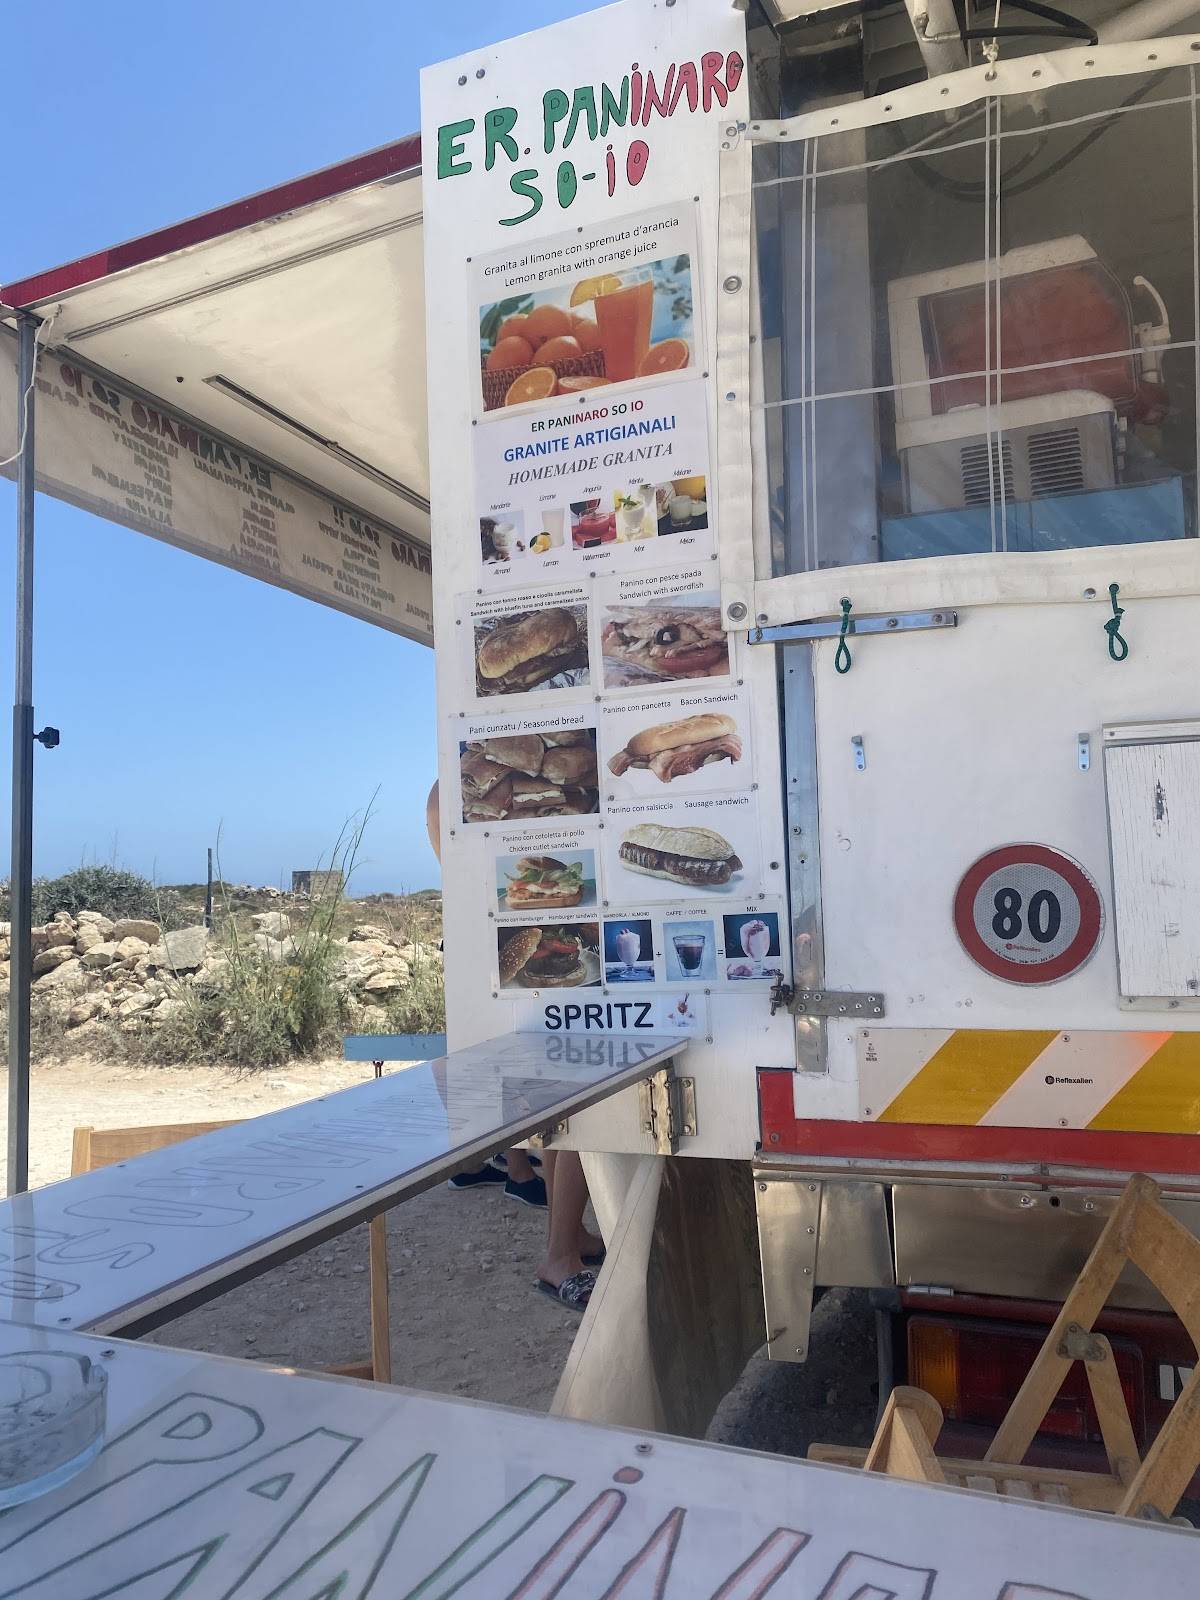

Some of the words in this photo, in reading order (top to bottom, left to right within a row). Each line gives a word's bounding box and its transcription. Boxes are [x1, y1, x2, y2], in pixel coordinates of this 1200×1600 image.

[438, 107, 530, 180] ER.
[484, 262, 517, 277] Granita
[520, 257, 528, 268] al
[530, 249, 562, 265] limone
[565, 244, 582, 254] con
[585, 231, 630, 252] spremuta
[505, 272, 536, 288] Lemon
[538, 264, 572, 281] granita
[574, 256, 595, 271] with
[598, 248, 632, 264] orange
[632, 240, 657, 259] juice
[531, 421, 545, 434] ER
[548, 407, 608, 430] PANINARO
[611, 403, 627, 416] SO
[631, 400, 644, 413] IO
[504, 437, 570, 464] GRANITE
[573, 415, 677, 449] ARTIGIANALI
[507, 456, 599, 486] HOMEMADE
[602, 442, 673, 468] GRANITA
[620, 578, 644, 588] Panino
[645, 577, 658, 585] con
[659, 574, 679, 584] pesce
[680, 569, 702, 581] spada
[619, 589, 652, 600] Sandwich
[653, 585, 669, 595] with
[670, 581, 704, 593] swordfish
[470, 608, 493, 617] Sandwich
[504, 604, 522, 612] bluefin
[475, 600, 493, 608] Panino
[602, 706, 624, 715] Panino
[642, 700, 672, 711] pancetta
[680, 697, 702, 706] Bacon
[704, 693, 739, 705] Sandwich
[469, 723, 485, 734] Pani
[487, 721, 516, 734] cunzatu
[523, 717, 560, 730] Seasoned
[561, 714, 584, 727] bread
[607, 806, 630, 814] Panino
[632, 804, 645, 812] con
[646, 801, 673, 811] salsiccia
[684, 799, 714, 809] Sausage
[715, 796, 749, 807] sandwich
[502, 834, 521, 843] Panino
[522, 833, 534, 841] con
[569, 829, 585, 838] pollo
[509, 844, 532, 853] Chicken
[532, 842, 550, 851] cutlet
[551, 841, 579, 851] sandwich
[746, 905, 758, 913] MIX
[992, 887, 1061, 944] 80
[545, 1002, 654, 1030] SPRITZ
